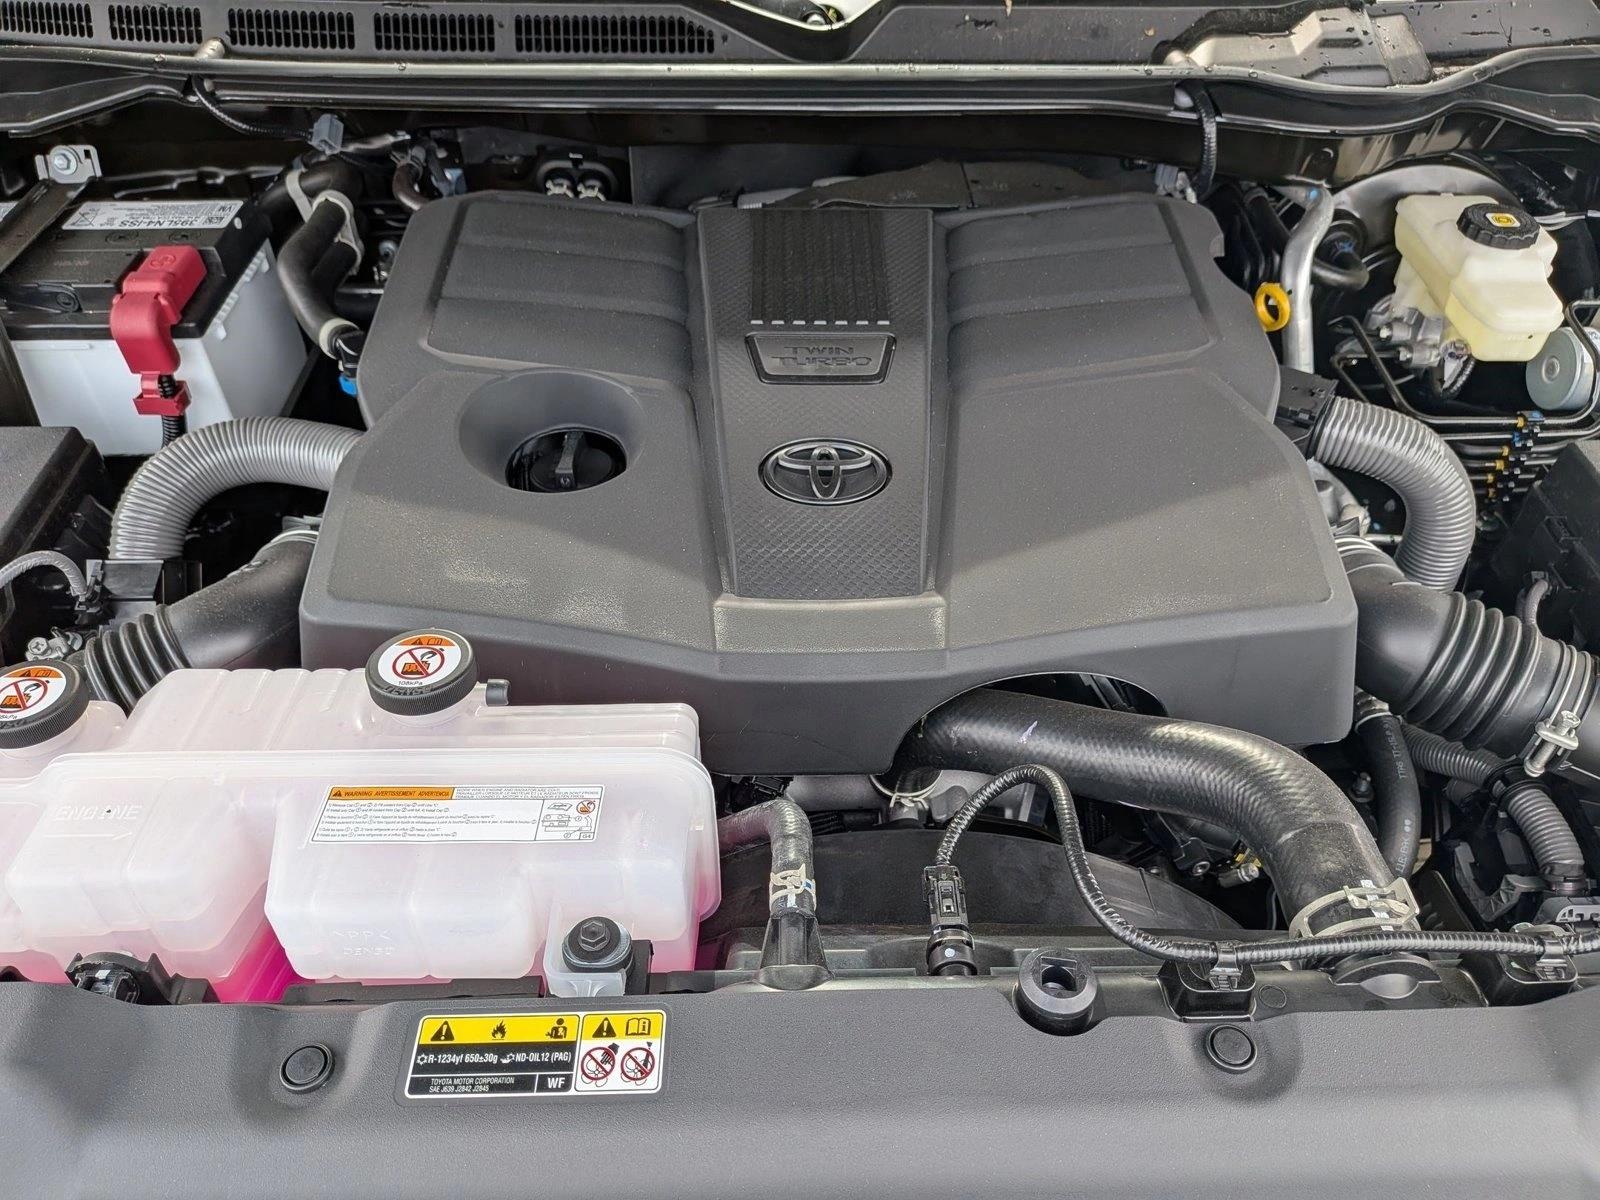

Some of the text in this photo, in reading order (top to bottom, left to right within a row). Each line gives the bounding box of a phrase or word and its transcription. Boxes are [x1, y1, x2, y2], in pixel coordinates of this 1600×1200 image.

[784, 346, 854, 355] TWIN
[771, 356, 873, 366] TURBO
[53, 804, 144, 821] ENGINE
[428, 1053, 464, 1066] R-1234yf
[464, 1052, 499, 1065] 650±30g
[550, 1051, 572, 1063] (PAG)
[453, 1077, 474, 1085] MOTOR
[474, 1076, 515, 1085] CORPORATION
[547, 1077, 566, 1089] WF
[429, 1085, 440, 1093] SAE
[440, 1085, 455, 1093] J639
